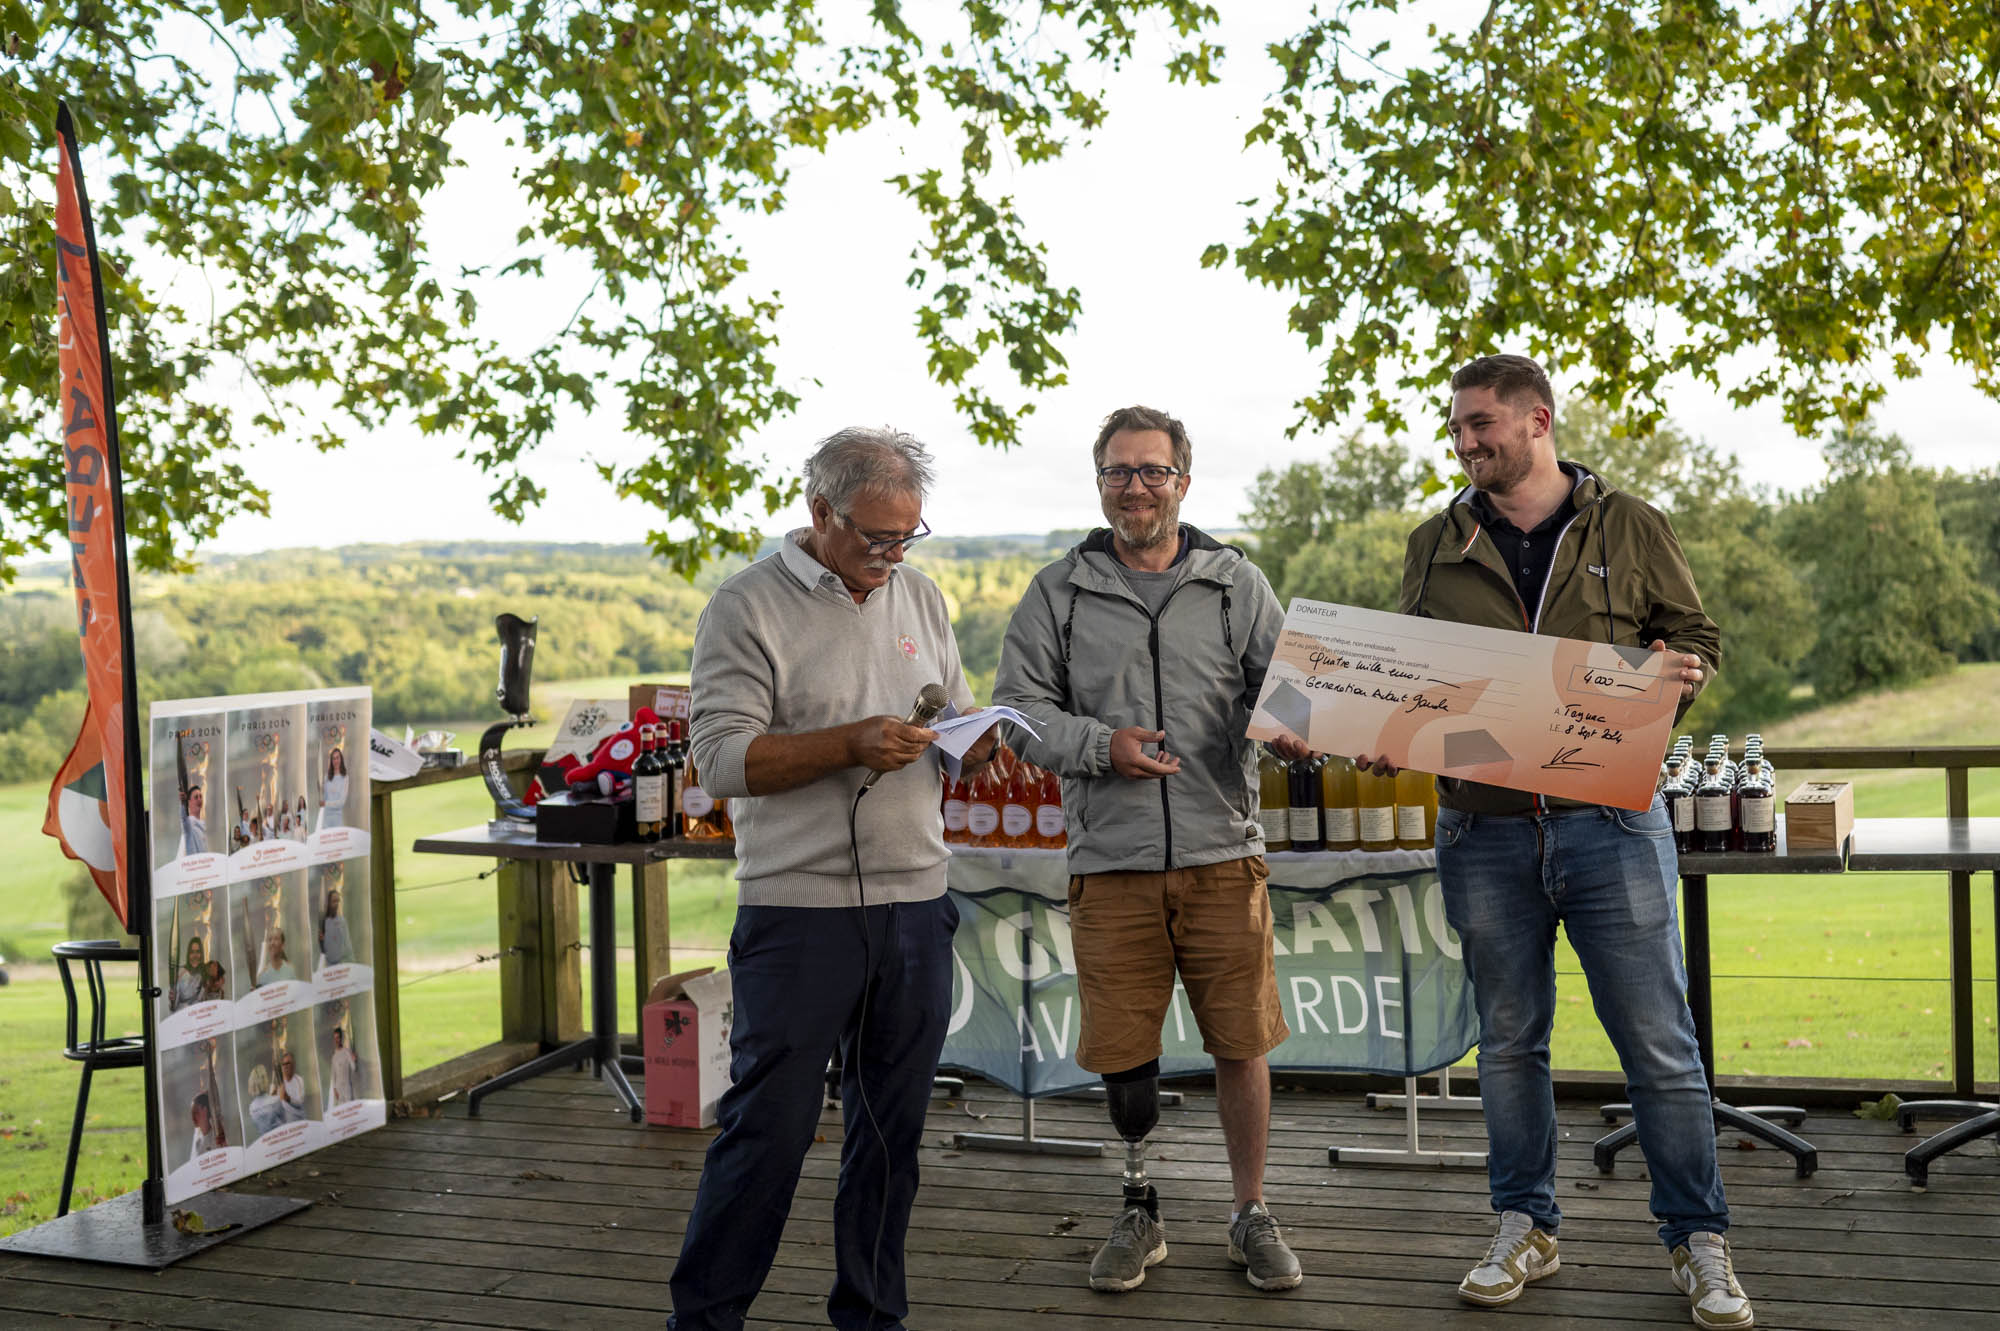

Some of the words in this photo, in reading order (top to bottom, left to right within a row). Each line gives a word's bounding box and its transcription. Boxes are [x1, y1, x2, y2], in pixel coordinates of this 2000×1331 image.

[1295, 604, 1337, 617] DONATEUR
[1309, 651, 1350, 671] Quatre
[1355, 660, 1386, 674] mille
[1388, 668, 1421, 681] euros
[310, 713, 334, 723] PARIS
[336, 710, 357, 721] 2024
[241, 720, 266, 731] PARIS
[269, 718, 291, 729] 2024
[1564, 724, 1575, 735] 8
[198, 726, 221, 737] 2024
